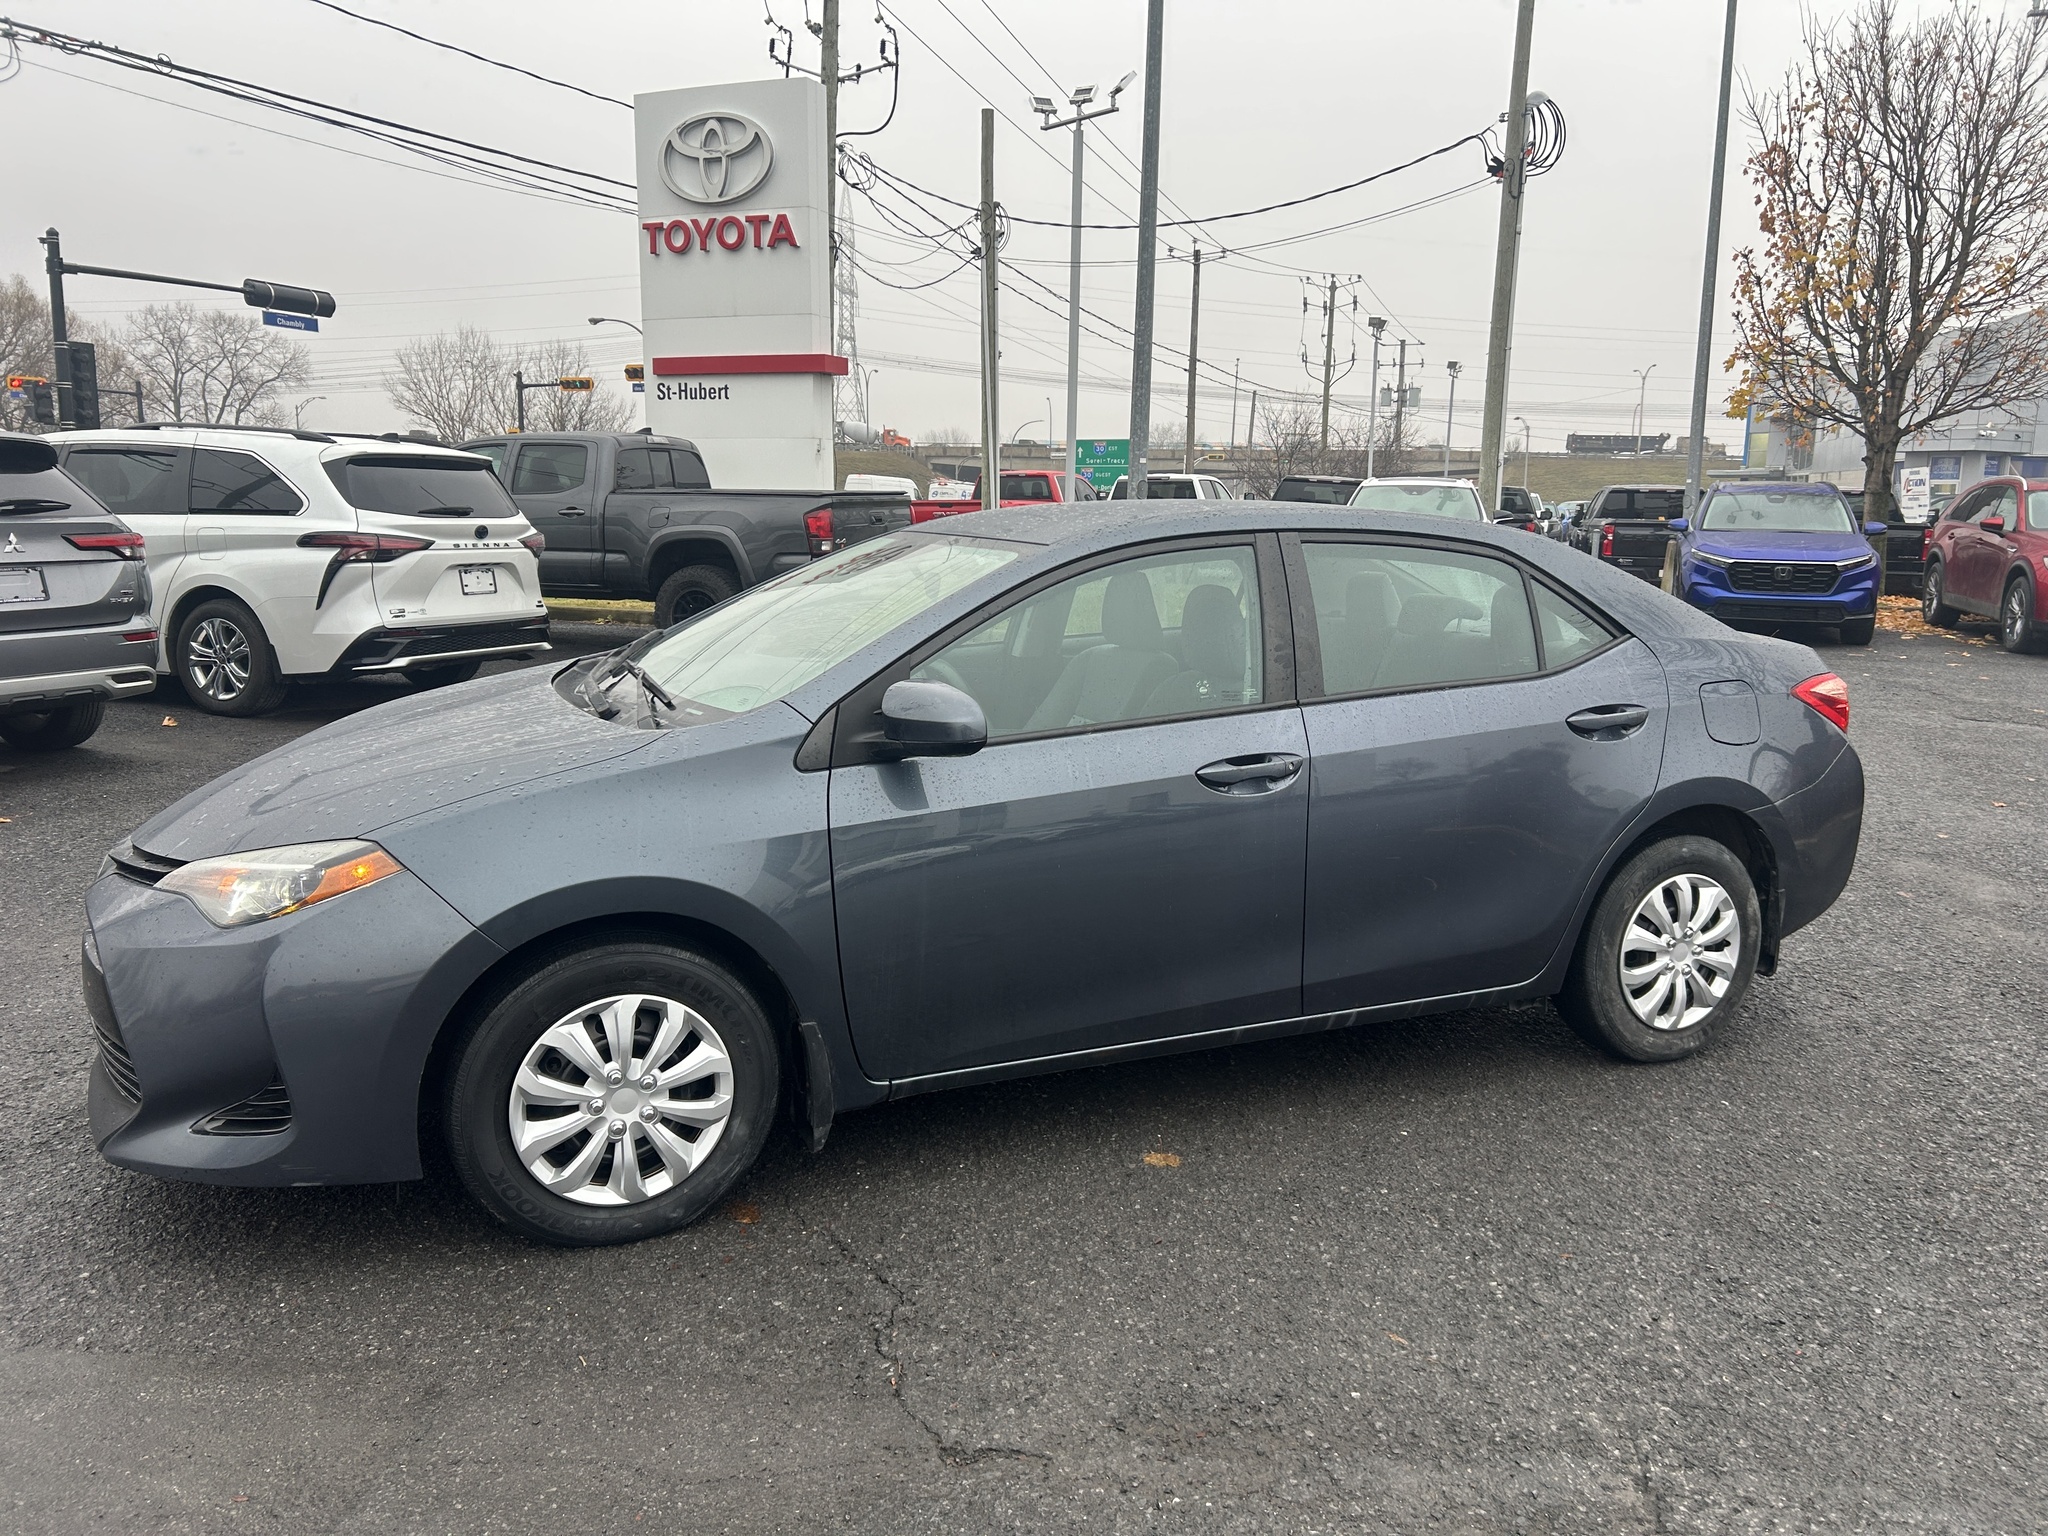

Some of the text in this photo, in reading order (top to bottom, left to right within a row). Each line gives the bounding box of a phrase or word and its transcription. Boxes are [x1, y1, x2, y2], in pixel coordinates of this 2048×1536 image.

[641, 213, 800, 255] TOYOTA
[277, 318, 305, 330] Chambly
[657, 382, 730, 400] St-Hubert
